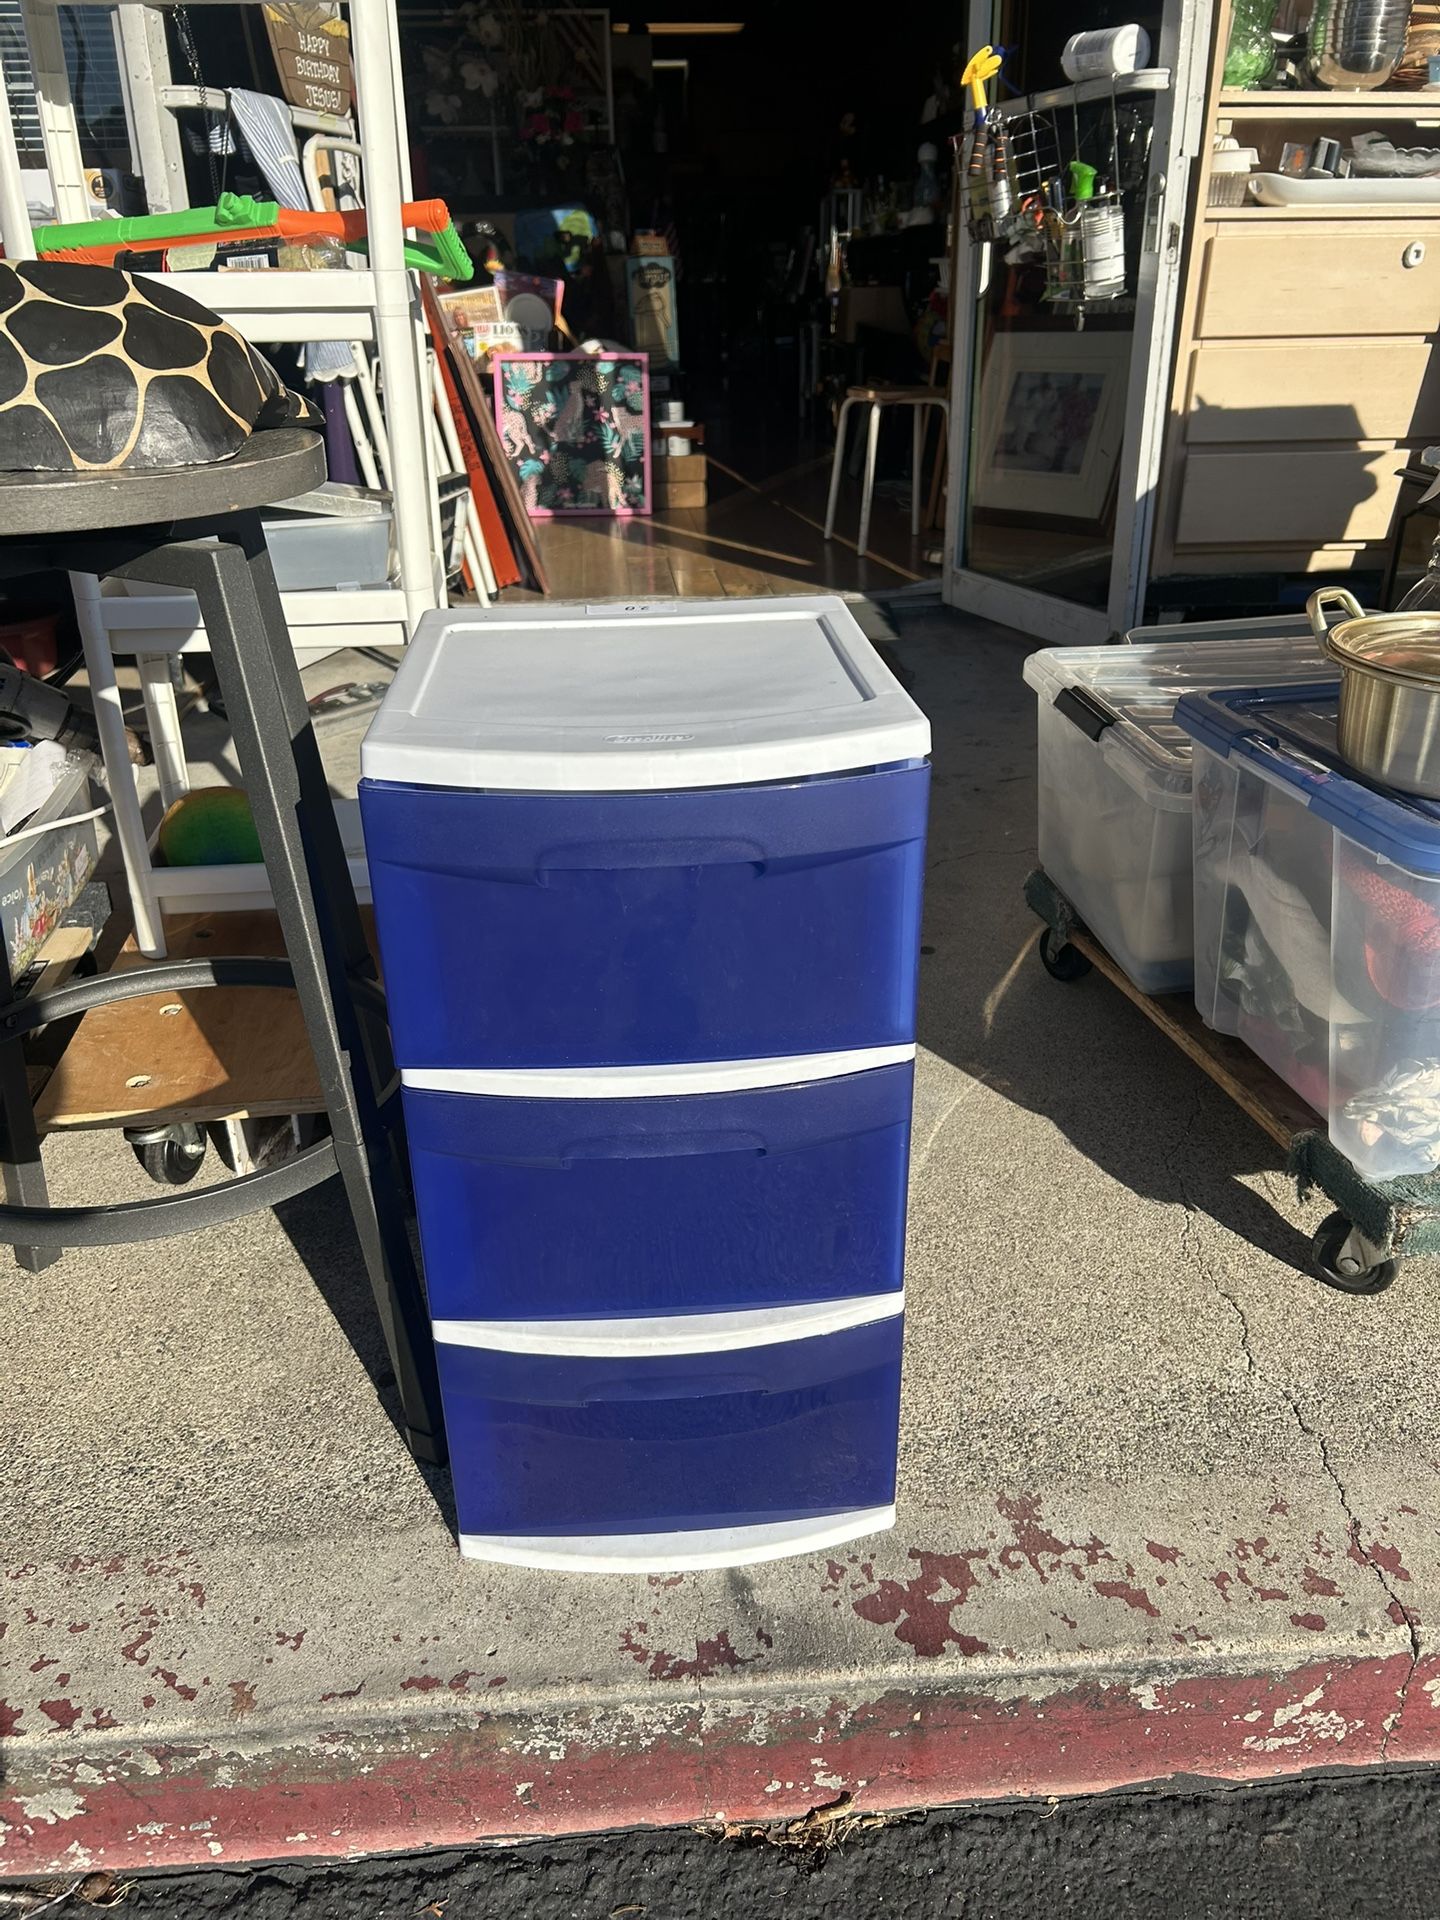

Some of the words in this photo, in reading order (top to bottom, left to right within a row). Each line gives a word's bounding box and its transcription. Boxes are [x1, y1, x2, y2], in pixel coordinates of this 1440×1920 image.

[298, 32, 330, 56] HAPPY
[295, 56, 340, 83] BIRTHDAY
[305, 85, 341, 110] JESUS!
[2, 888, 24, 906] Voice
